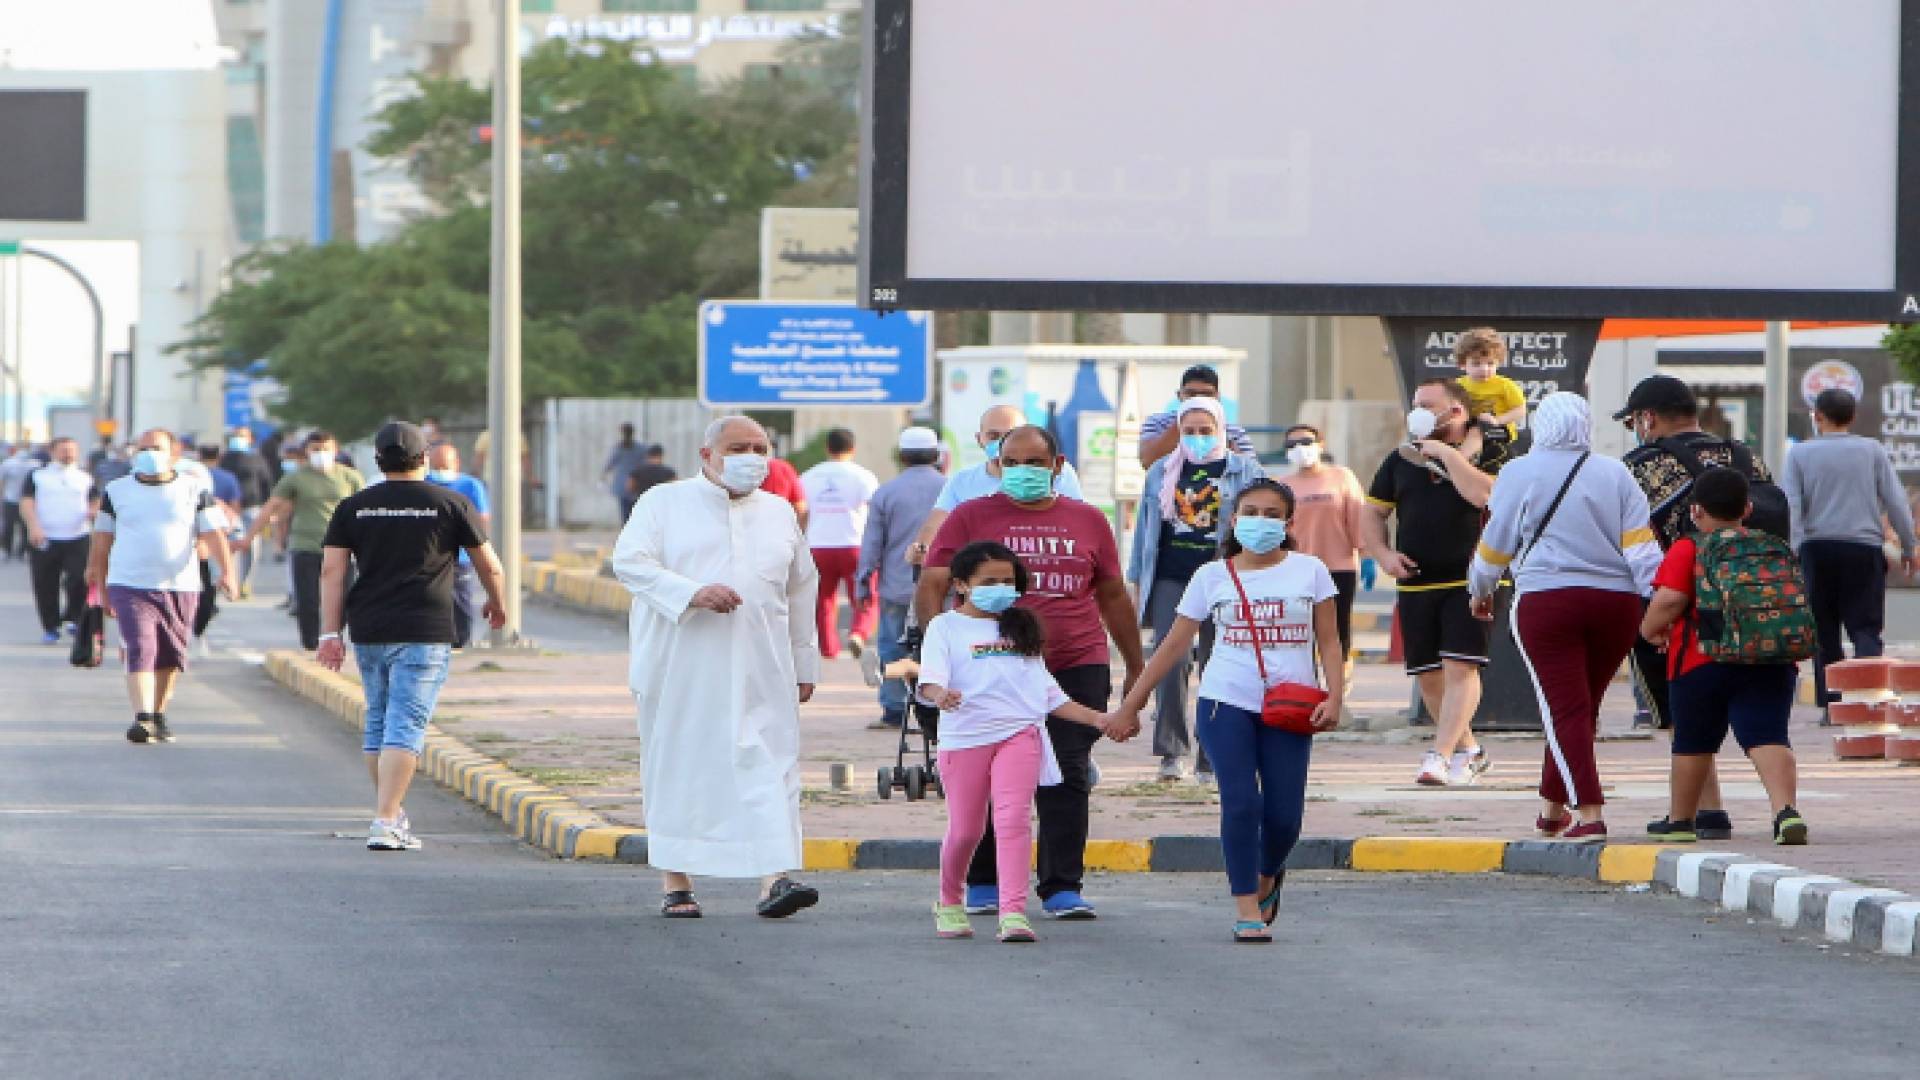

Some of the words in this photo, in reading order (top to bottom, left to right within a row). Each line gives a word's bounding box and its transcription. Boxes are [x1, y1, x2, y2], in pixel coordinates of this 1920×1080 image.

[1498, 332, 1567, 349] FECT
[1003, 536, 1076, 555] UNITY
[1031, 571, 1084, 593] TORY
